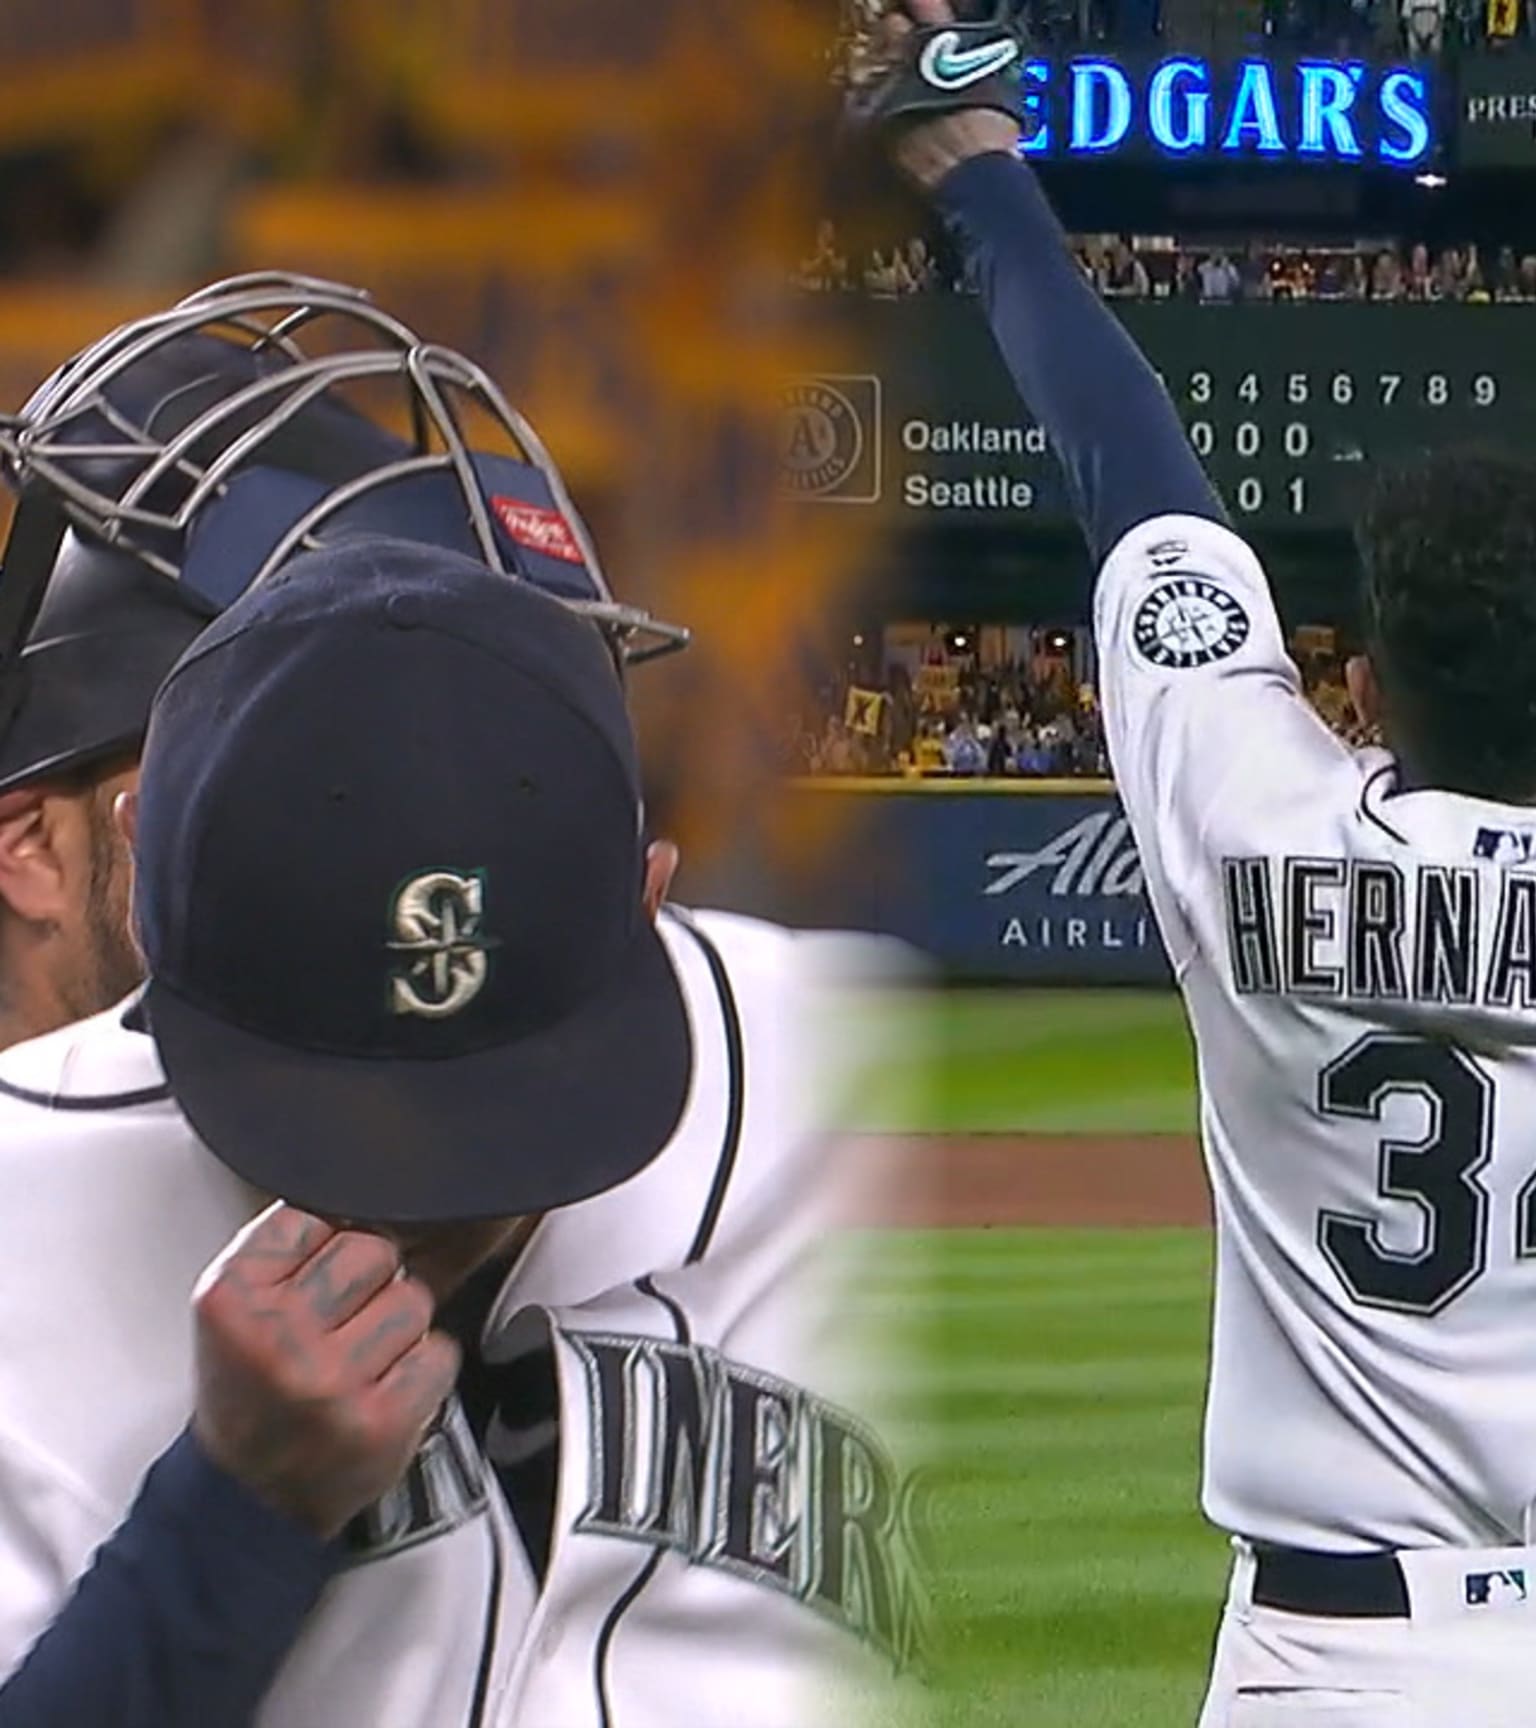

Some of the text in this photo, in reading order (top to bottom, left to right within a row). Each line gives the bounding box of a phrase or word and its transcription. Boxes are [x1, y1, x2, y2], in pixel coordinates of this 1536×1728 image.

[1190, 373, 1212, 402] 3
[1237, 373, 1260, 402] 4
[1287, 374, 1309, 402] 5
[1332, 375, 1353, 404] 6
[1380, 375, 1401, 404] 7
[1427, 375, 1448, 404] 8
[1474, 376, 1496, 405] 9
[902, 420, 1047, 454] Oakland
[1236, 422, 1260, 455] 0
[1284, 422, 1308, 455] 0
[904, 475, 1033, 508] Seattle
[1238, 478, 1261, 512] 0
[1288, 478, 1305, 512] 1
[387, 867, 500, 1019] S
[1001, 917, 1147, 948] AIRLI
